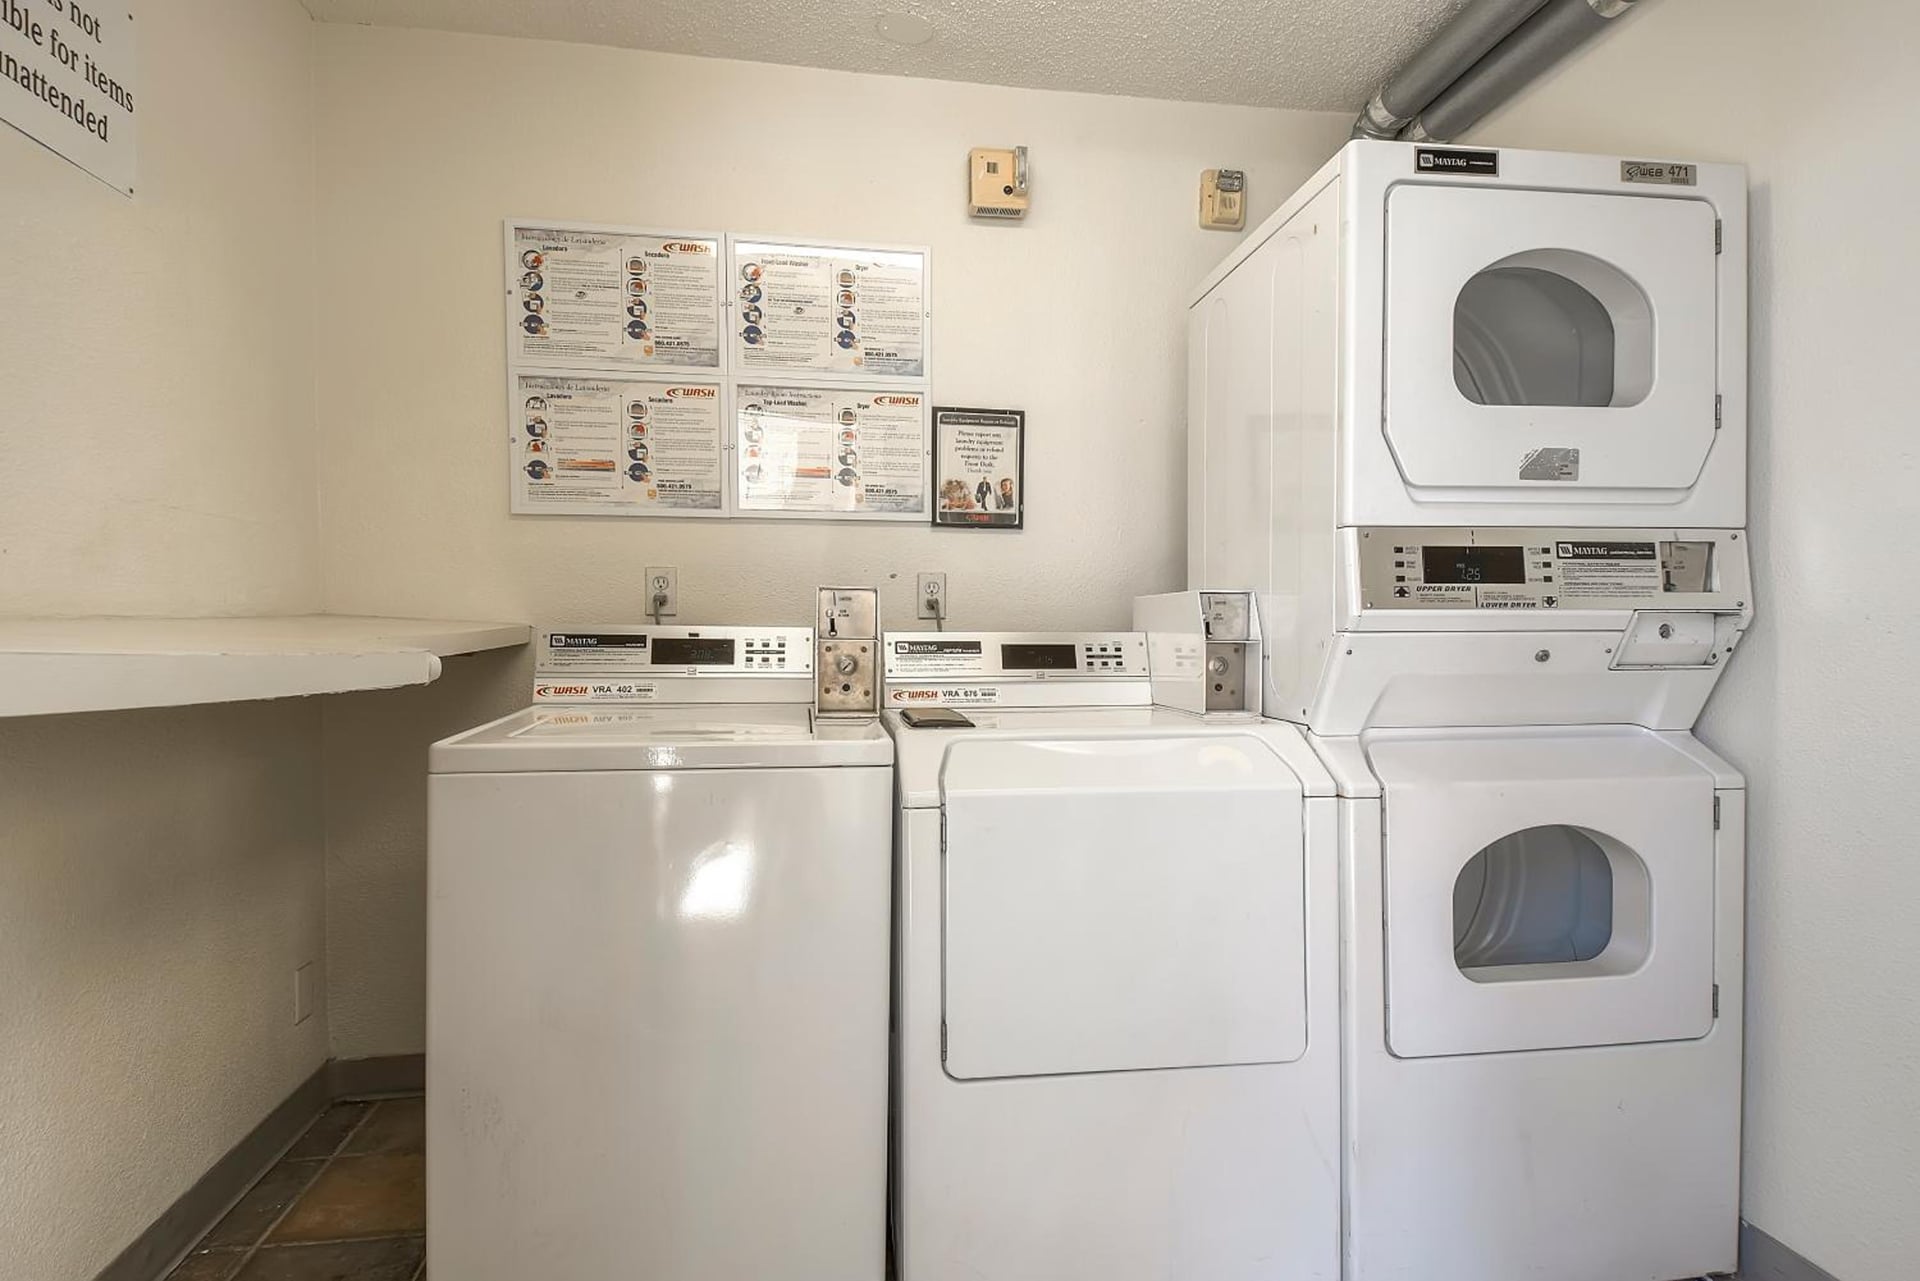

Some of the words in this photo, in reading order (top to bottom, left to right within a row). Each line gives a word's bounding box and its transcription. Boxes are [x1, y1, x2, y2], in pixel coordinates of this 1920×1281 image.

[48, 0, 63, 12] s
[70, 1, 101, 43] not
[50, 29, 78, 72] for
[85, 54, 133, 113] items
[1434, 156, 1467, 167] MAYTAG
[1640, 167, 1664, 177] WEB
[1669, 165, 1688, 177] 471
[682, 388, 715, 397] WASH
[889, 396, 919, 404] WASH
[1574, 547, 1607, 555] MAYTAG
[566, 637, 597, 645] MAYTAG
[553, 683, 588, 694] WASH
[592, 683, 612, 693] VRA
[616, 683, 633, 693] 402
[908, 690, 938, 699] WASH
[942, 690, 960, 698] VRA
